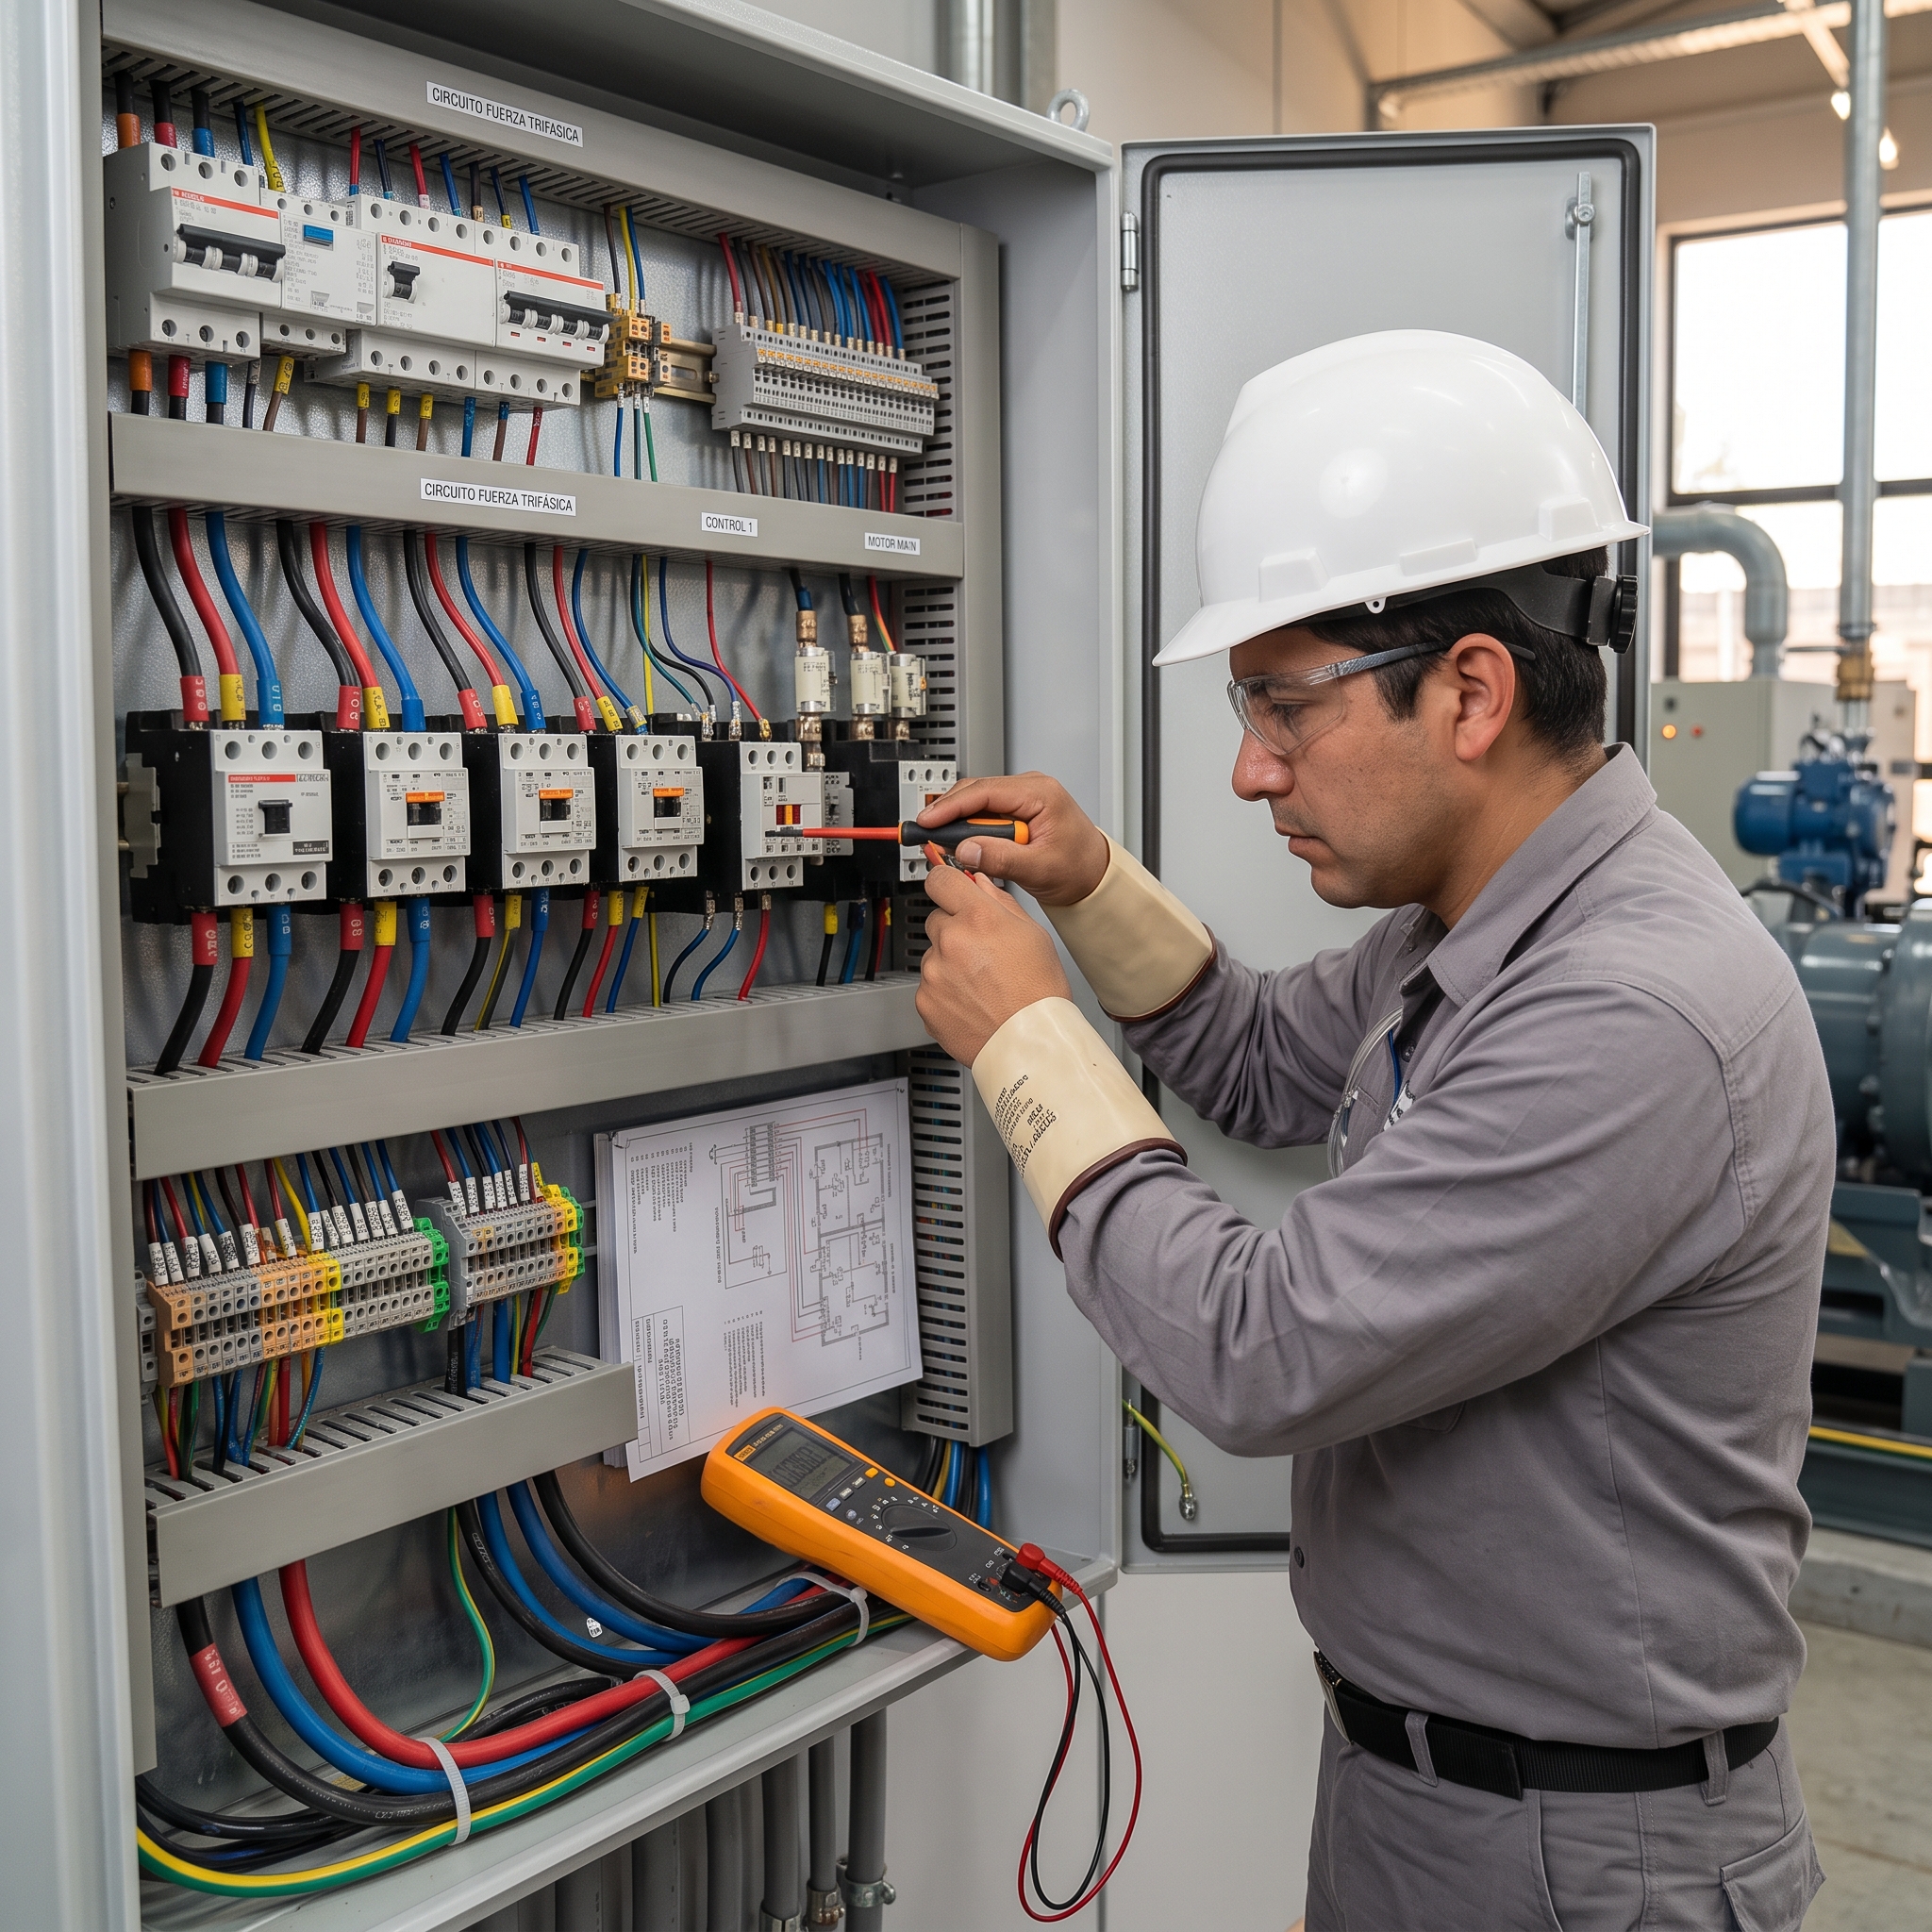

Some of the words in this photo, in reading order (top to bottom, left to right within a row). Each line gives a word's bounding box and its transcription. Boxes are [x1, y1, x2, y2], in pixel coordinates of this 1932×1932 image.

[432, 87, 483, 114] CIRCUITO
[486, 103, 526, 127] FUERZA
[527, 115, 579, 142] TRIFASICA
[425, 482, 475, 501] CIRCUITO
[478, 489, 519, 506] FUERZA
[521, 493, 573, 511] TRIFÁSICA
[706, 516, 746, 532] CONTROL
[748, 522, 752, 532] 1
[868, 535, 896, 549] MOTOR
